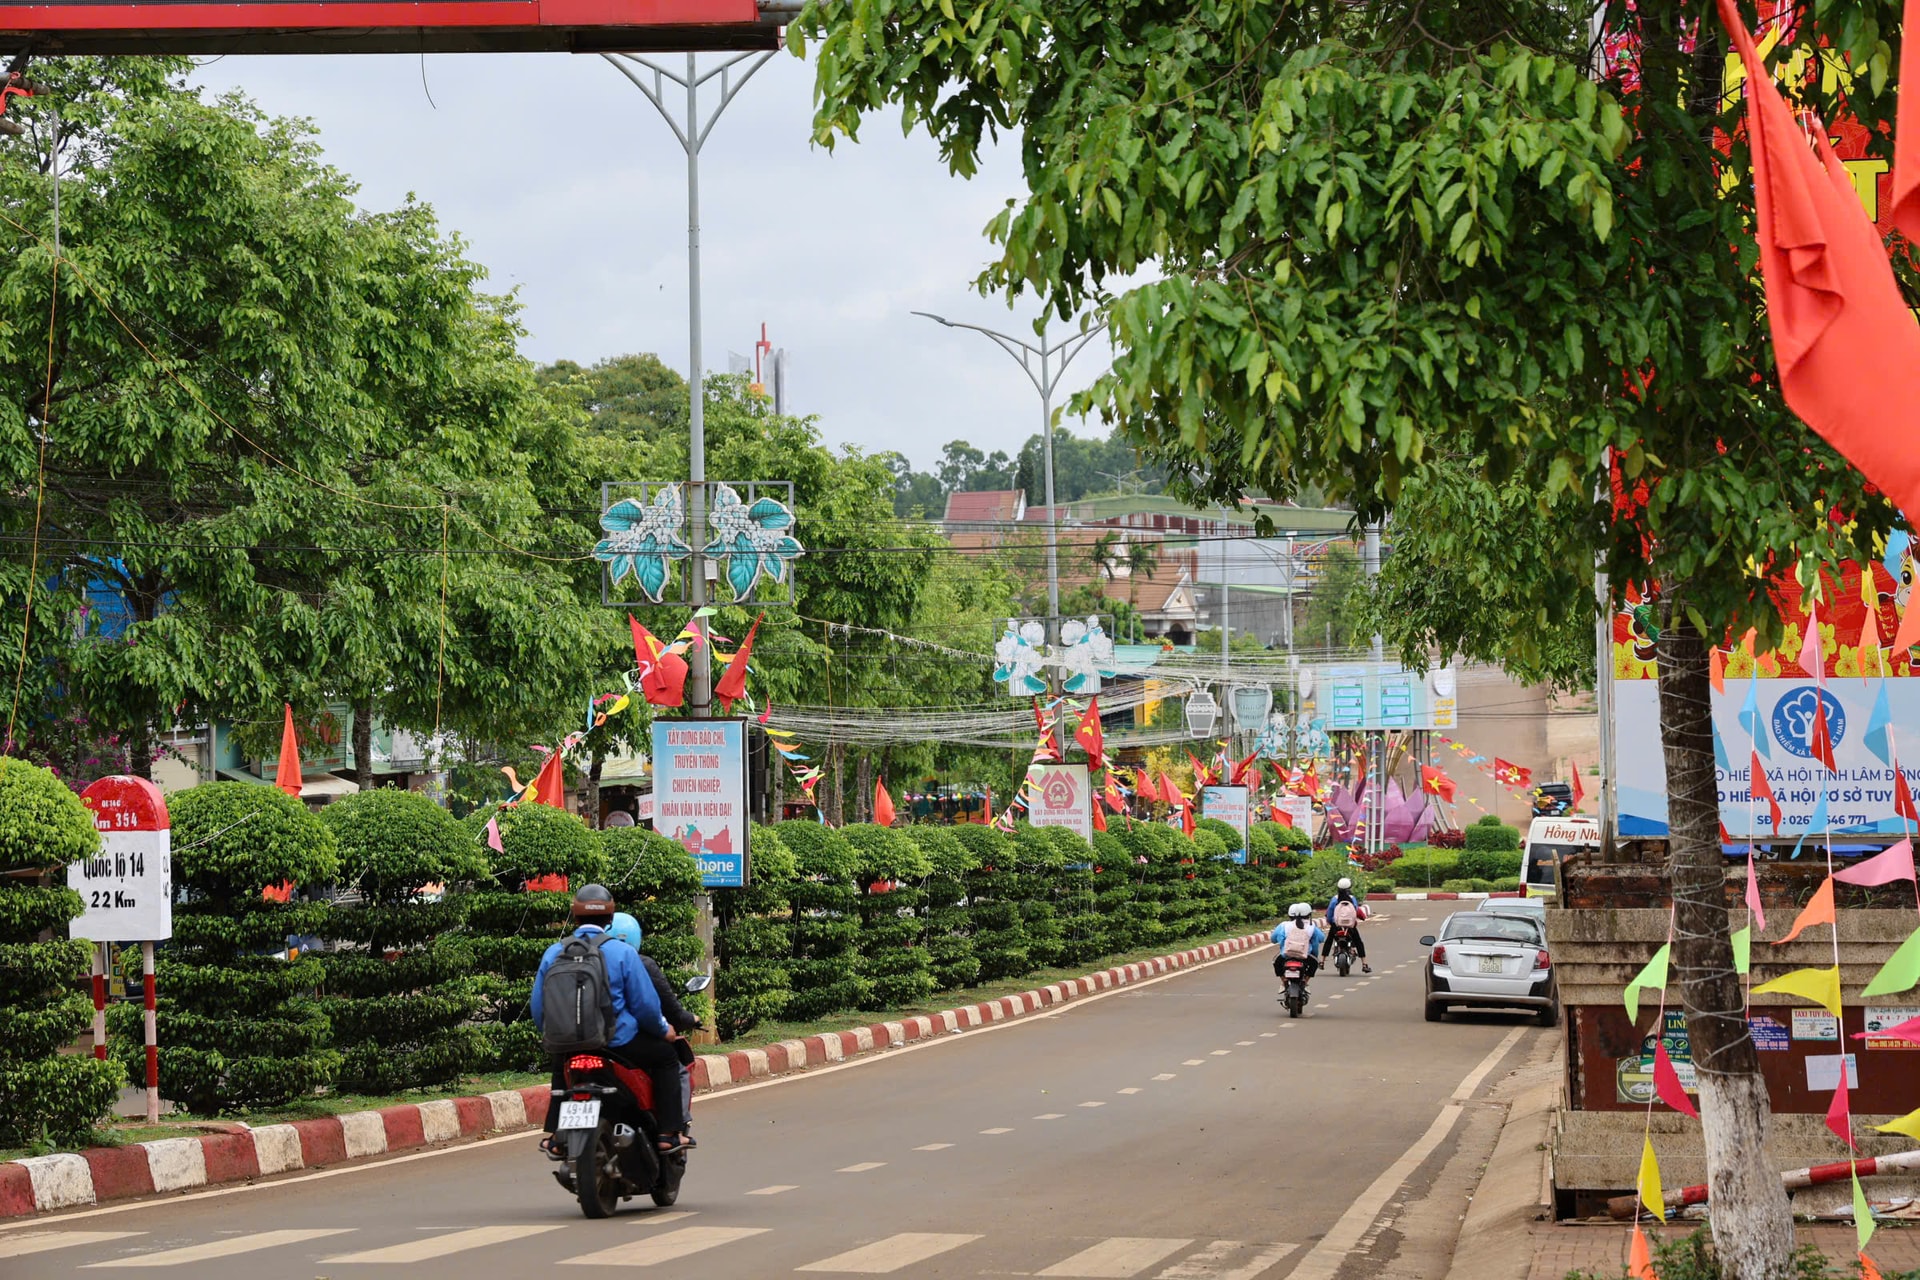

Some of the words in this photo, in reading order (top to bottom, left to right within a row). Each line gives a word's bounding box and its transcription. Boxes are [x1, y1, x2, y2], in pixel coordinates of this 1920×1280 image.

[1836, 718, 1845, 736] NAM
[667, 728, 679, 745] XÂY
[681, 729, 698, 748] DỰNG
[699, 727, 711, 745] BÁO
[674, 750, 698, 769] TRUYỀN
[699, 752, 719, 769] THÔNG
[1729, 766, 1751, 782] HIỂ
[1766, 766, 1784, 782] XÃ
[1788, 766, 1812, 784] HỘI
[1852, 766, 1881, 781] LÂM
[1884, 764, 1920, 781] ĐỒN
[672, 776, 697, 793] CHUYÊN
[1791, 787, 1816, 805] HỘI
[1843, 786, 1863, 803] SỞ
[1865, 790, 1893, 803] TUY
[661, 800, 679, 817] NHÂN
[680, 800, 693, 817] VĂN
[694, 800, 703, 817] VÀ
[703, 800, 718, 820] HIỆN
[93, 810, 111, 829] Km
[115, 811, 138, 828] 354
[1757, 815, 1772, 825] SĐ
[1848, 815, 1867, 825] 771
[1544, 824, 1576, 842] Hồng
[115, 852, 126, 883] lộ
[129, 852, 144, 878] 14
[697, 858, 734, 872] hone
[115, 890, 136, 908] Km
[566, 1103, 593, 1114] 49-AA
